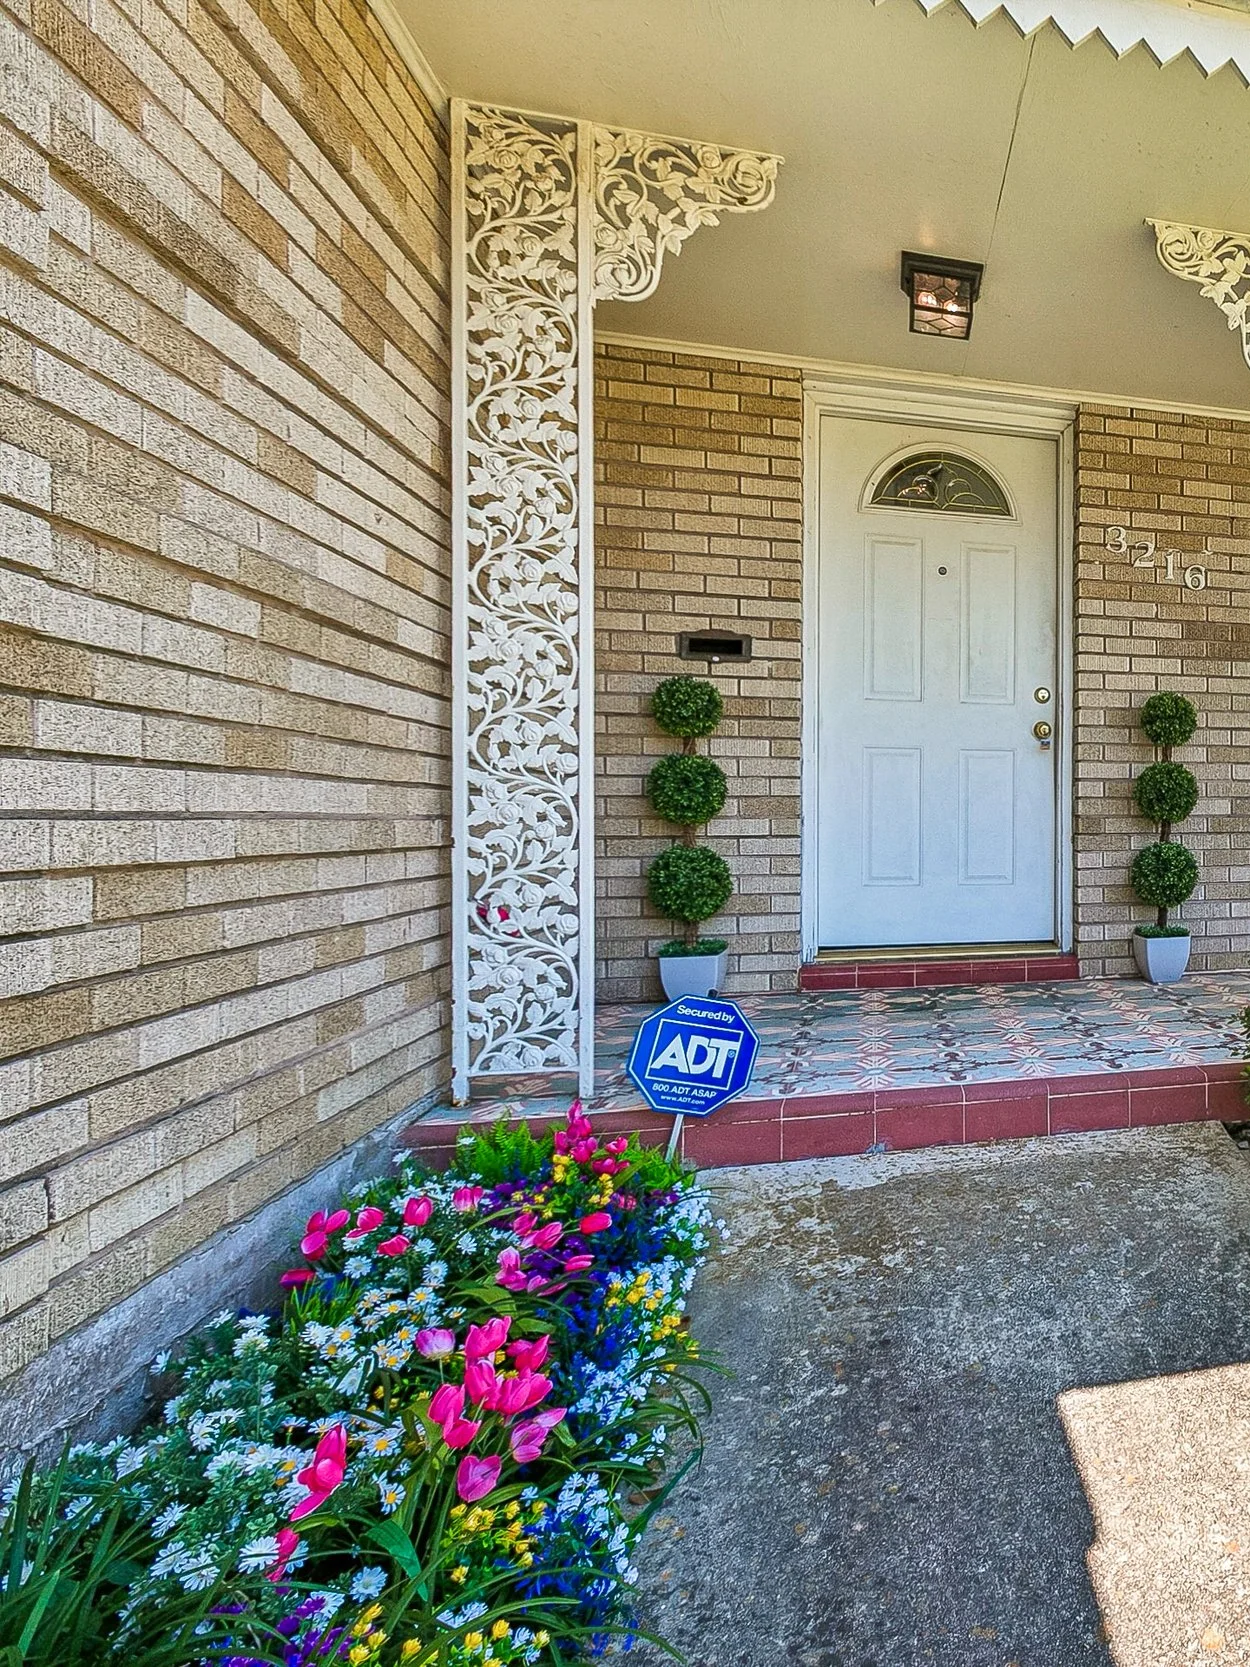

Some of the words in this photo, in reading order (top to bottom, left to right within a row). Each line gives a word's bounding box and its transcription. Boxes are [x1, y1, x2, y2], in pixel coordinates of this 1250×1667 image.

[1105, 526, 1206, 591] 3216
[677, 1005, 721, 1020] Secured
[721, 1012, 735, 1024] by
[650, 1033, 740, 1078] ADT
[660, 1095, 706, 1105] www.ADT.com
